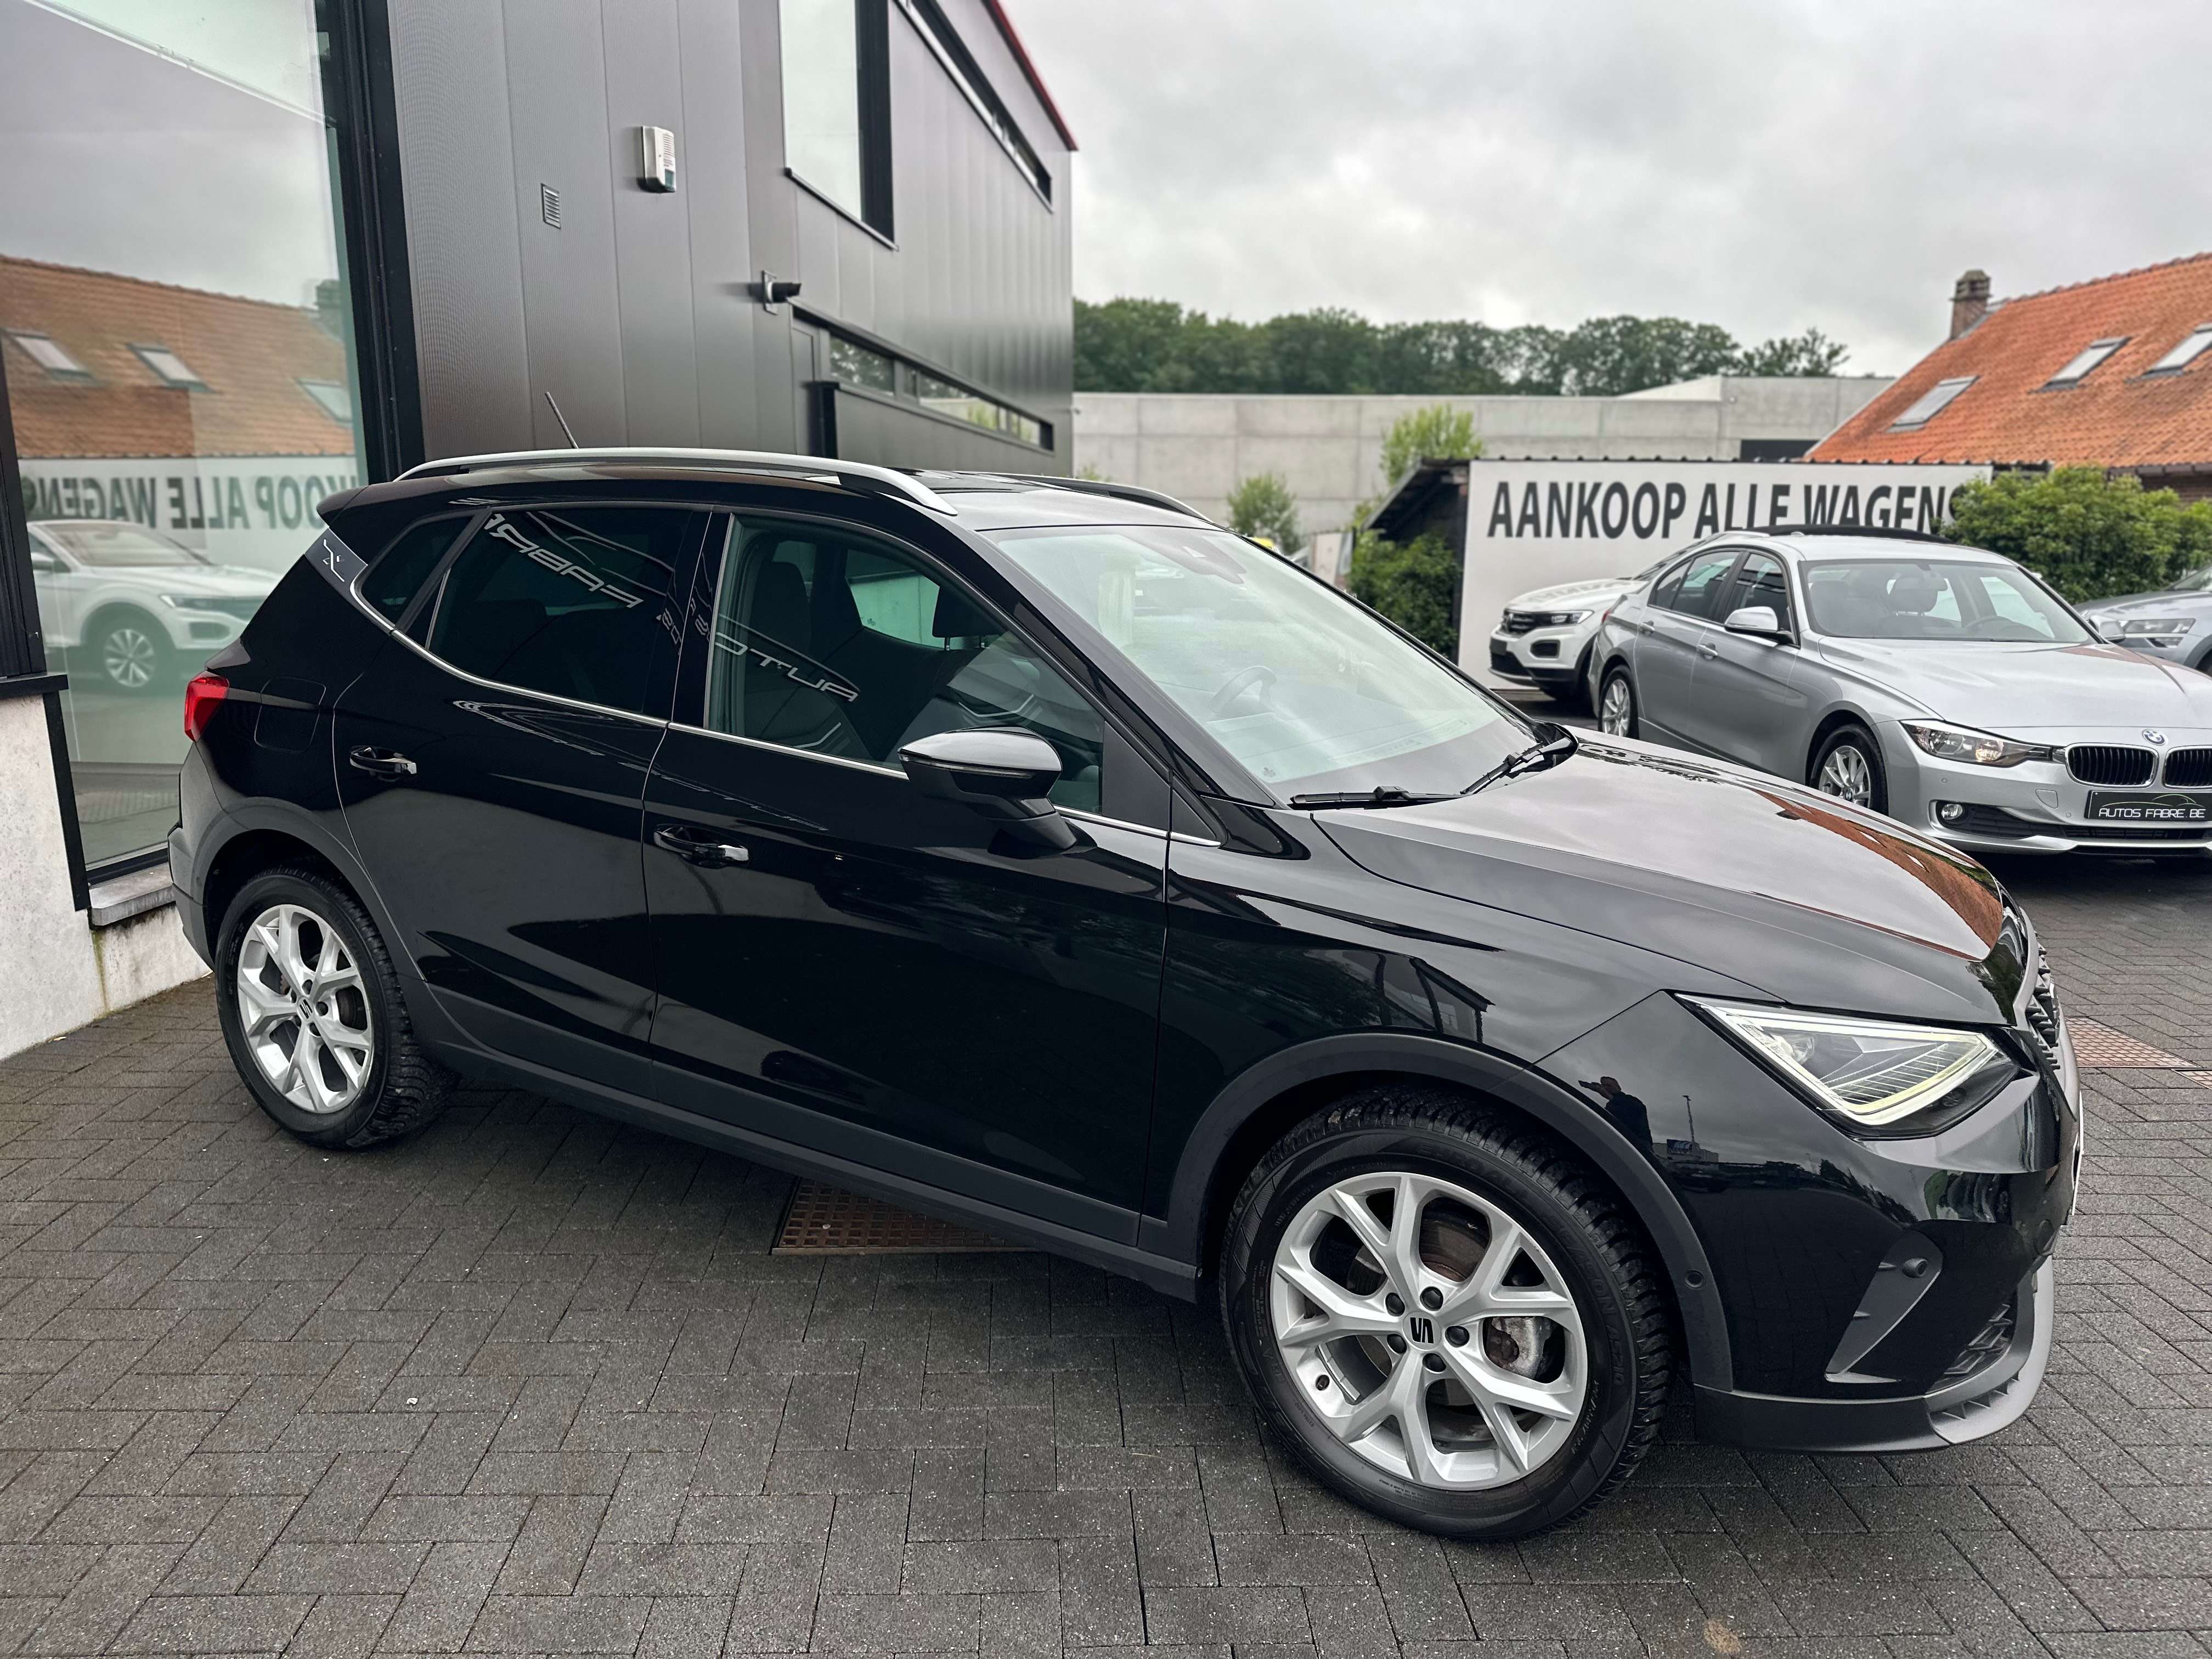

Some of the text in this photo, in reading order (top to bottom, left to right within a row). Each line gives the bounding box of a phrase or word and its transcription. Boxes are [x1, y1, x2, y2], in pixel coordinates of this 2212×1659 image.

[1487, 481, 1686, 539] AANKOOP
[1694, 483, 1791, 539] ALLE
[2098, 808, 2141, 818] AUTOS
